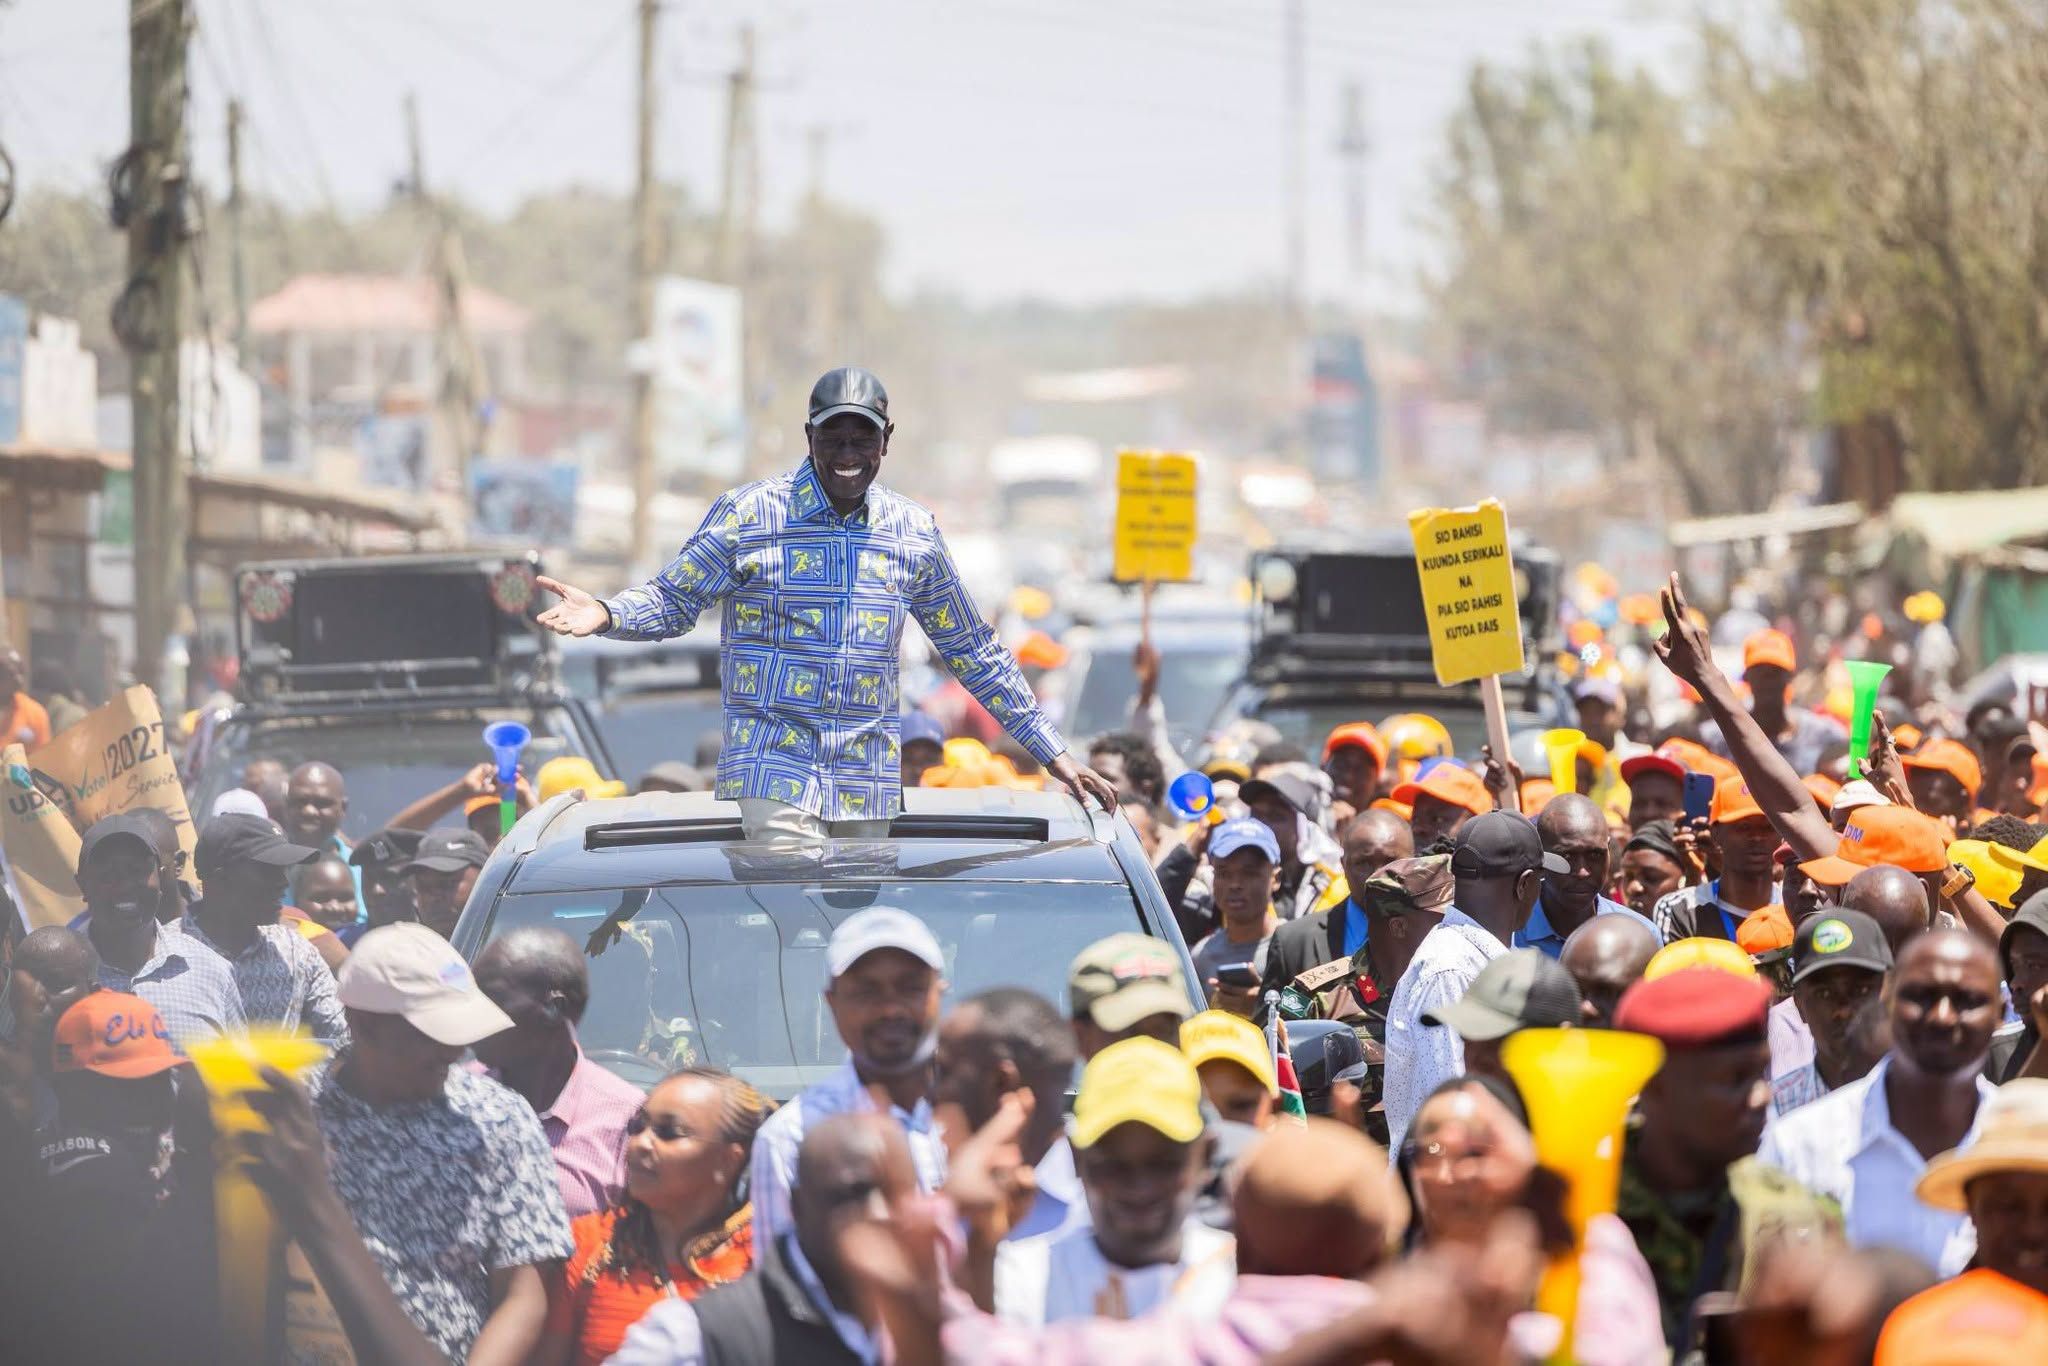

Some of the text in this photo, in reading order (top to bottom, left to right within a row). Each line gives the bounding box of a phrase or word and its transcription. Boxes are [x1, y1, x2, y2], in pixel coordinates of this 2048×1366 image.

[1435, 523, 1482, 544] SIO RAHISI
[1422, 544, 1504, 570] KUUNDA SERIKALI
[1459, 575, 1473, 588] NA
[1438, 594, 1502, 616] PIA SIO RAHISI
[1445, 619, 1499, 640] KUTOA RAIS
